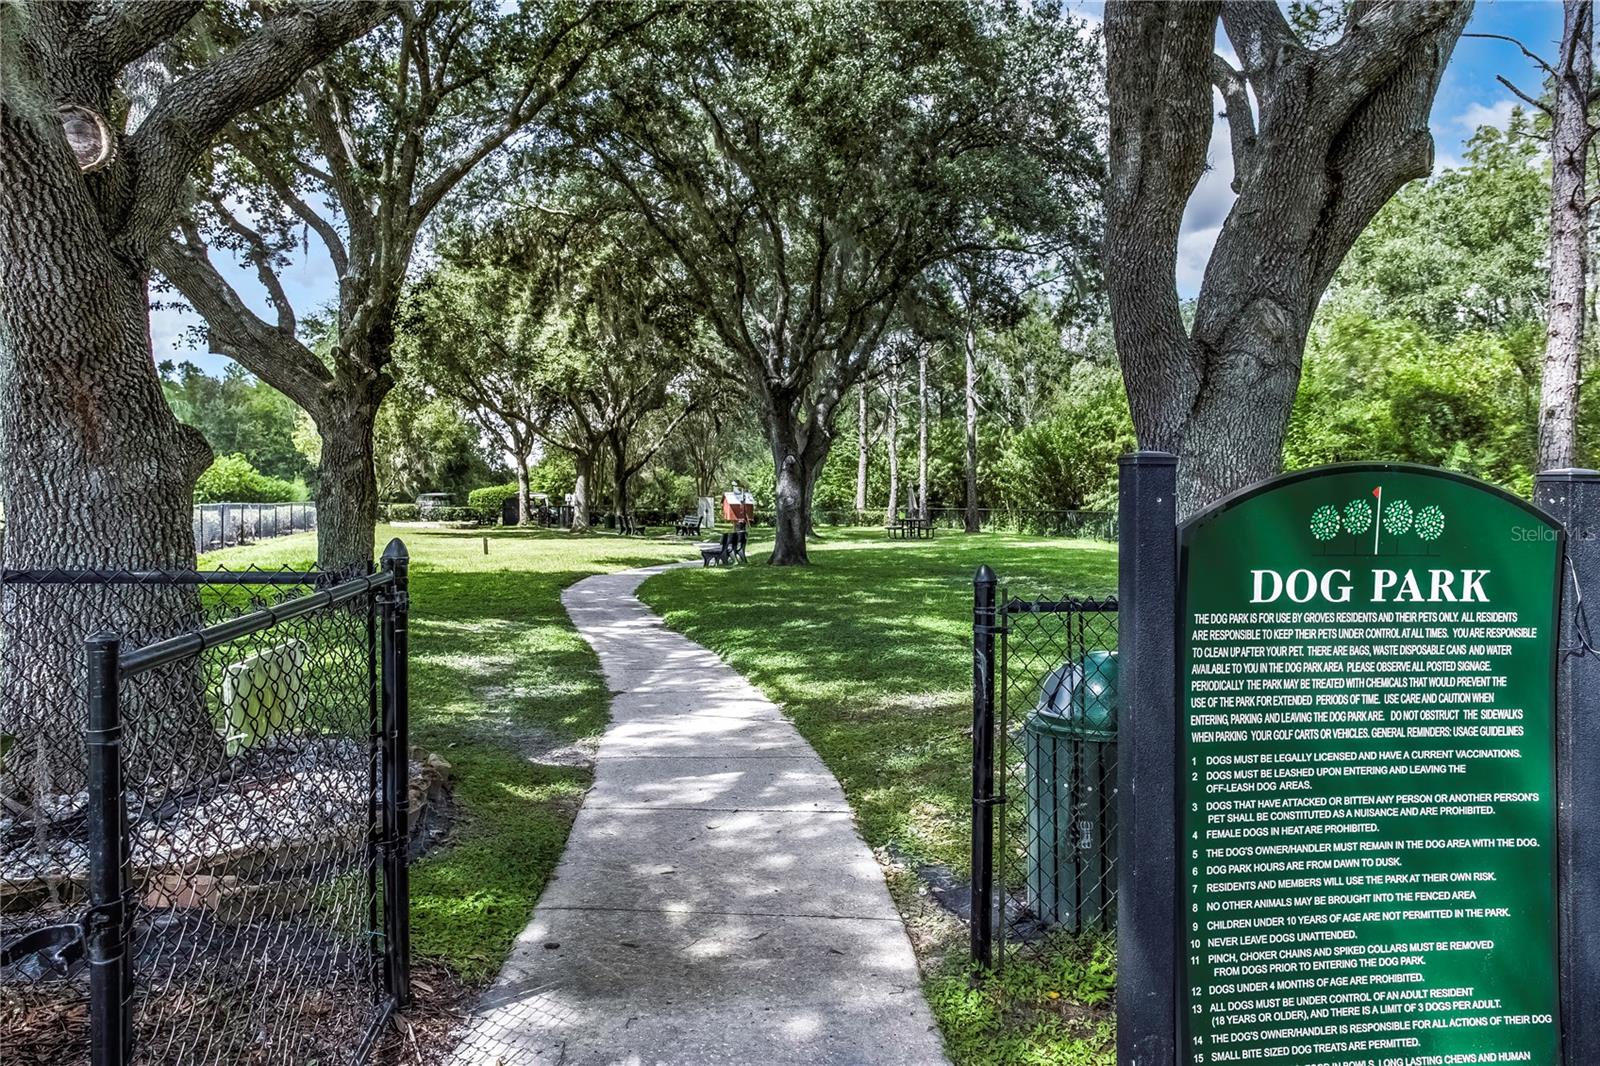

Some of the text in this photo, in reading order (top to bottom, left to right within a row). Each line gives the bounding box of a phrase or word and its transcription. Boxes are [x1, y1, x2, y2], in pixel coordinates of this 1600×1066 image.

[1249, 569, 1490, 603] DOG PARK
[1194, 612, 1517, 624] THE DOG PARK IS FOR USE BY GROVES RESIDENTS AND THEIR PETS ONLY. ALL RESIDENTS
[1191, 676, 1506, 691] PERIODICALLY THE PARK MAY BE TREATED WITH CHEMICALS THAT WOULD PREVENT THE
[1191, 725, 1524, 742] WHEN PARKING YOUR GOLF CARTS OR VEHICLES. GENERAL REMINDERS: USAGE GUIDELINES
[1206, 755, 1232, 764] DOGS
[1233, 754, 1258, 763] MUST
[1260, 754, 1272, 762] BE
[1274, 753, 1312, 762] LEGALLY
[1313, 751, 1357, 761] LICENSED
[1357, 751, 1377, 760] AND
[1378, 750, 1401, 759] HAVE
[1411, 749, 1453, 759] CURRENT
[1455, 748, 1522, 758] VACCINATIONS.
[1192, 764, 1466, 780] 2 DOGS MUST BE LEASHED UPON ENTERING AND LEAVING THE
[1205, 780, 1313, 792] OFF-LEASH DOG AREAS.
[1207, 805, 1496, 823] PET SHALL BE CONSTITUTED AS A NUISANCE AND ARE PROHIBITED.
[1206, 828, 1241, 838] FEMALE
[1242, 827, 1268, 836] DOGS
[1270, 826, 1279, 835] IN
[1281, 825, 1304, 835] HEAT
[1304, 825, 1322, 834] ARE
[1324, 822, 1380, 833] PROHIBITED.
[1192, 857, 1402, 875] 6 DOG PARK HOURS ARE FROM DAWN TO DUSK.
[1192, 890, 1476, 912] 8 NO OTHER ANIMALS MAY BE BROUGHT INTO THE FENCED AREA
[1190, 929, 1358, 948] 10 NEVER LEAVE DOGS UNATTENDED.
[1190, 939, 1494, 964] 11 PINCH, CHOKER CHAINS AND SPIKED COLLARS MUST BE REMOVED
[1213, 955, 1426, 976] FROM DOGS PRIOR TO ENTERING THE DOG PARK.
[1191, 972, 1425, 995] 12 DOGS UNDER 4 MONTHS OF AGE ARE PROHIBITED.
[1193, 1036, 1421, 1062] 15 SMALL BITE SIZED DOG TREATS ARE PERMITTED.
[1378, 1057, 1404, 1066] LONG
[1404, 1055, 1443, 1066] LASTING
[1443, 1053, 1477, 1064] CHEWS
[1477, 1052, 1497, 1062] AND
[1498, 1050, 1530, 1061] HUMAN
